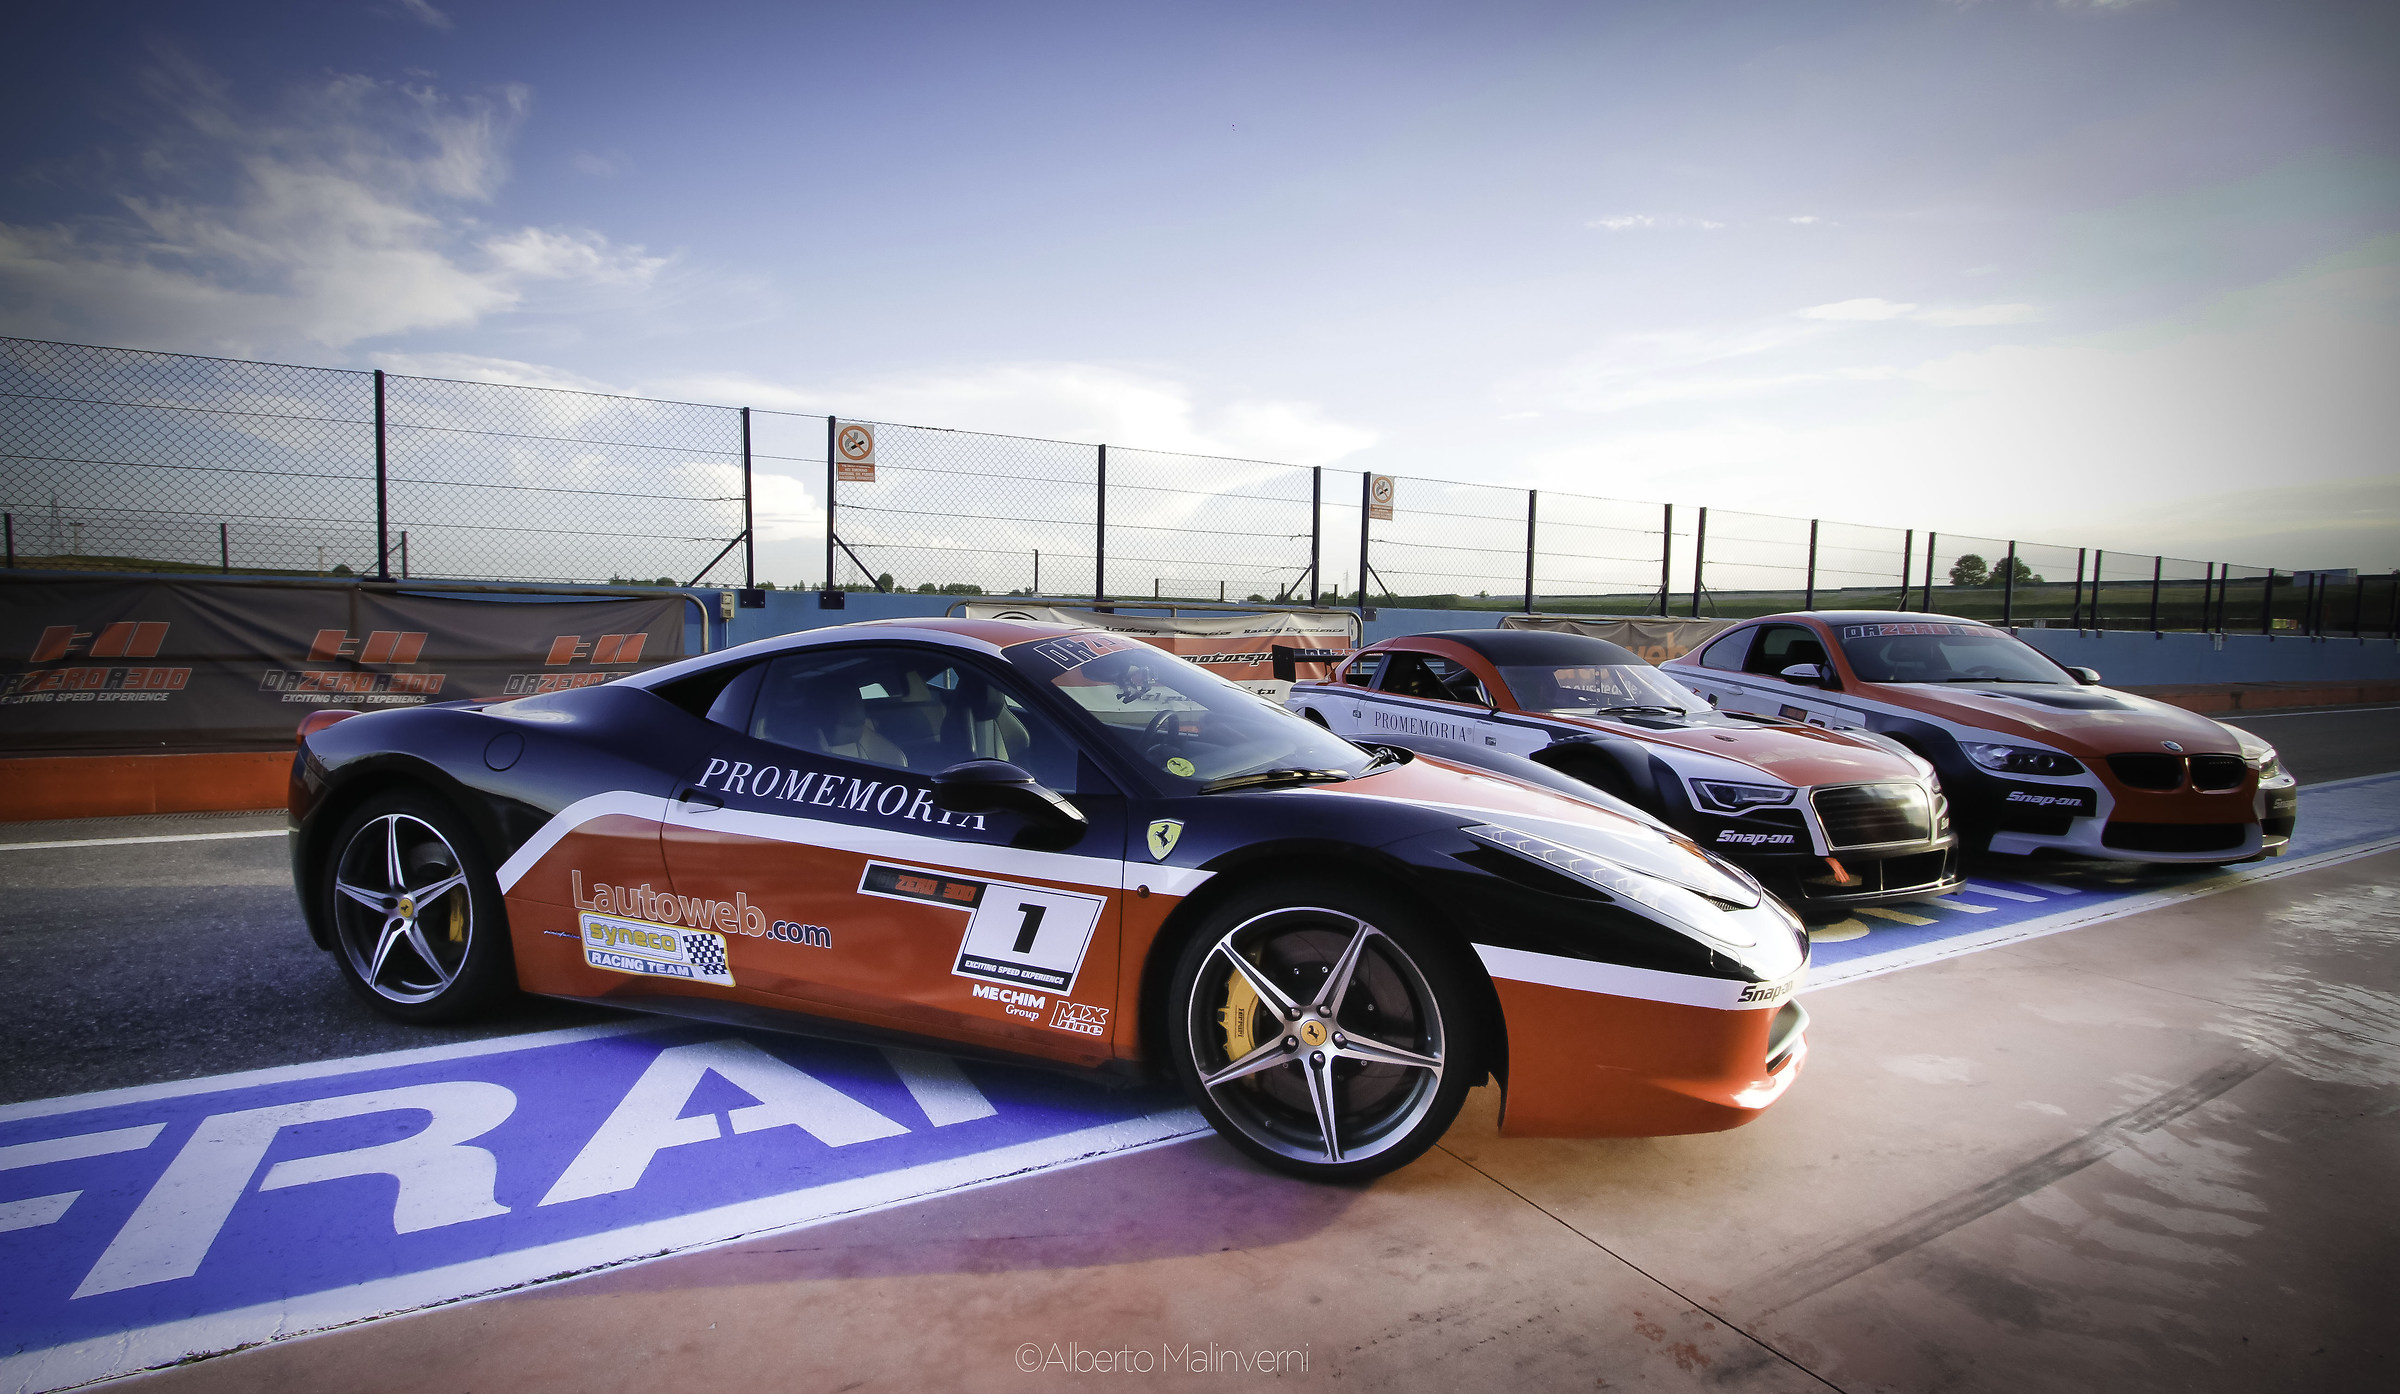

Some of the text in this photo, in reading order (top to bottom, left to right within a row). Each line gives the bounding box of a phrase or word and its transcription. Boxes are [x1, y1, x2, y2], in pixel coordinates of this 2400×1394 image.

[56, 692, 95, 702] SPEED
[97, 692, 170, 702] EXPERIENCE
[281, 693, 428, 704] EXCITING SPEED EXPERIENCE
[2006, 791, 2082, 806] Snap-on
[1716, 829, 1794, 846] Snap-on
[571, 869, 832, 949] Lautoweb.com
[590, 922, 676, 952] syneco
[1012, 902, 1048, 954] 1
[591, 951, 690, 976] RACING TEAM
[964, 960, 1065, 985] EXCITING SPEED EXPERIENCE
[972, 983, 1046, 1009] MECHIM
[1005, 1004, 1040, 1021] Group
